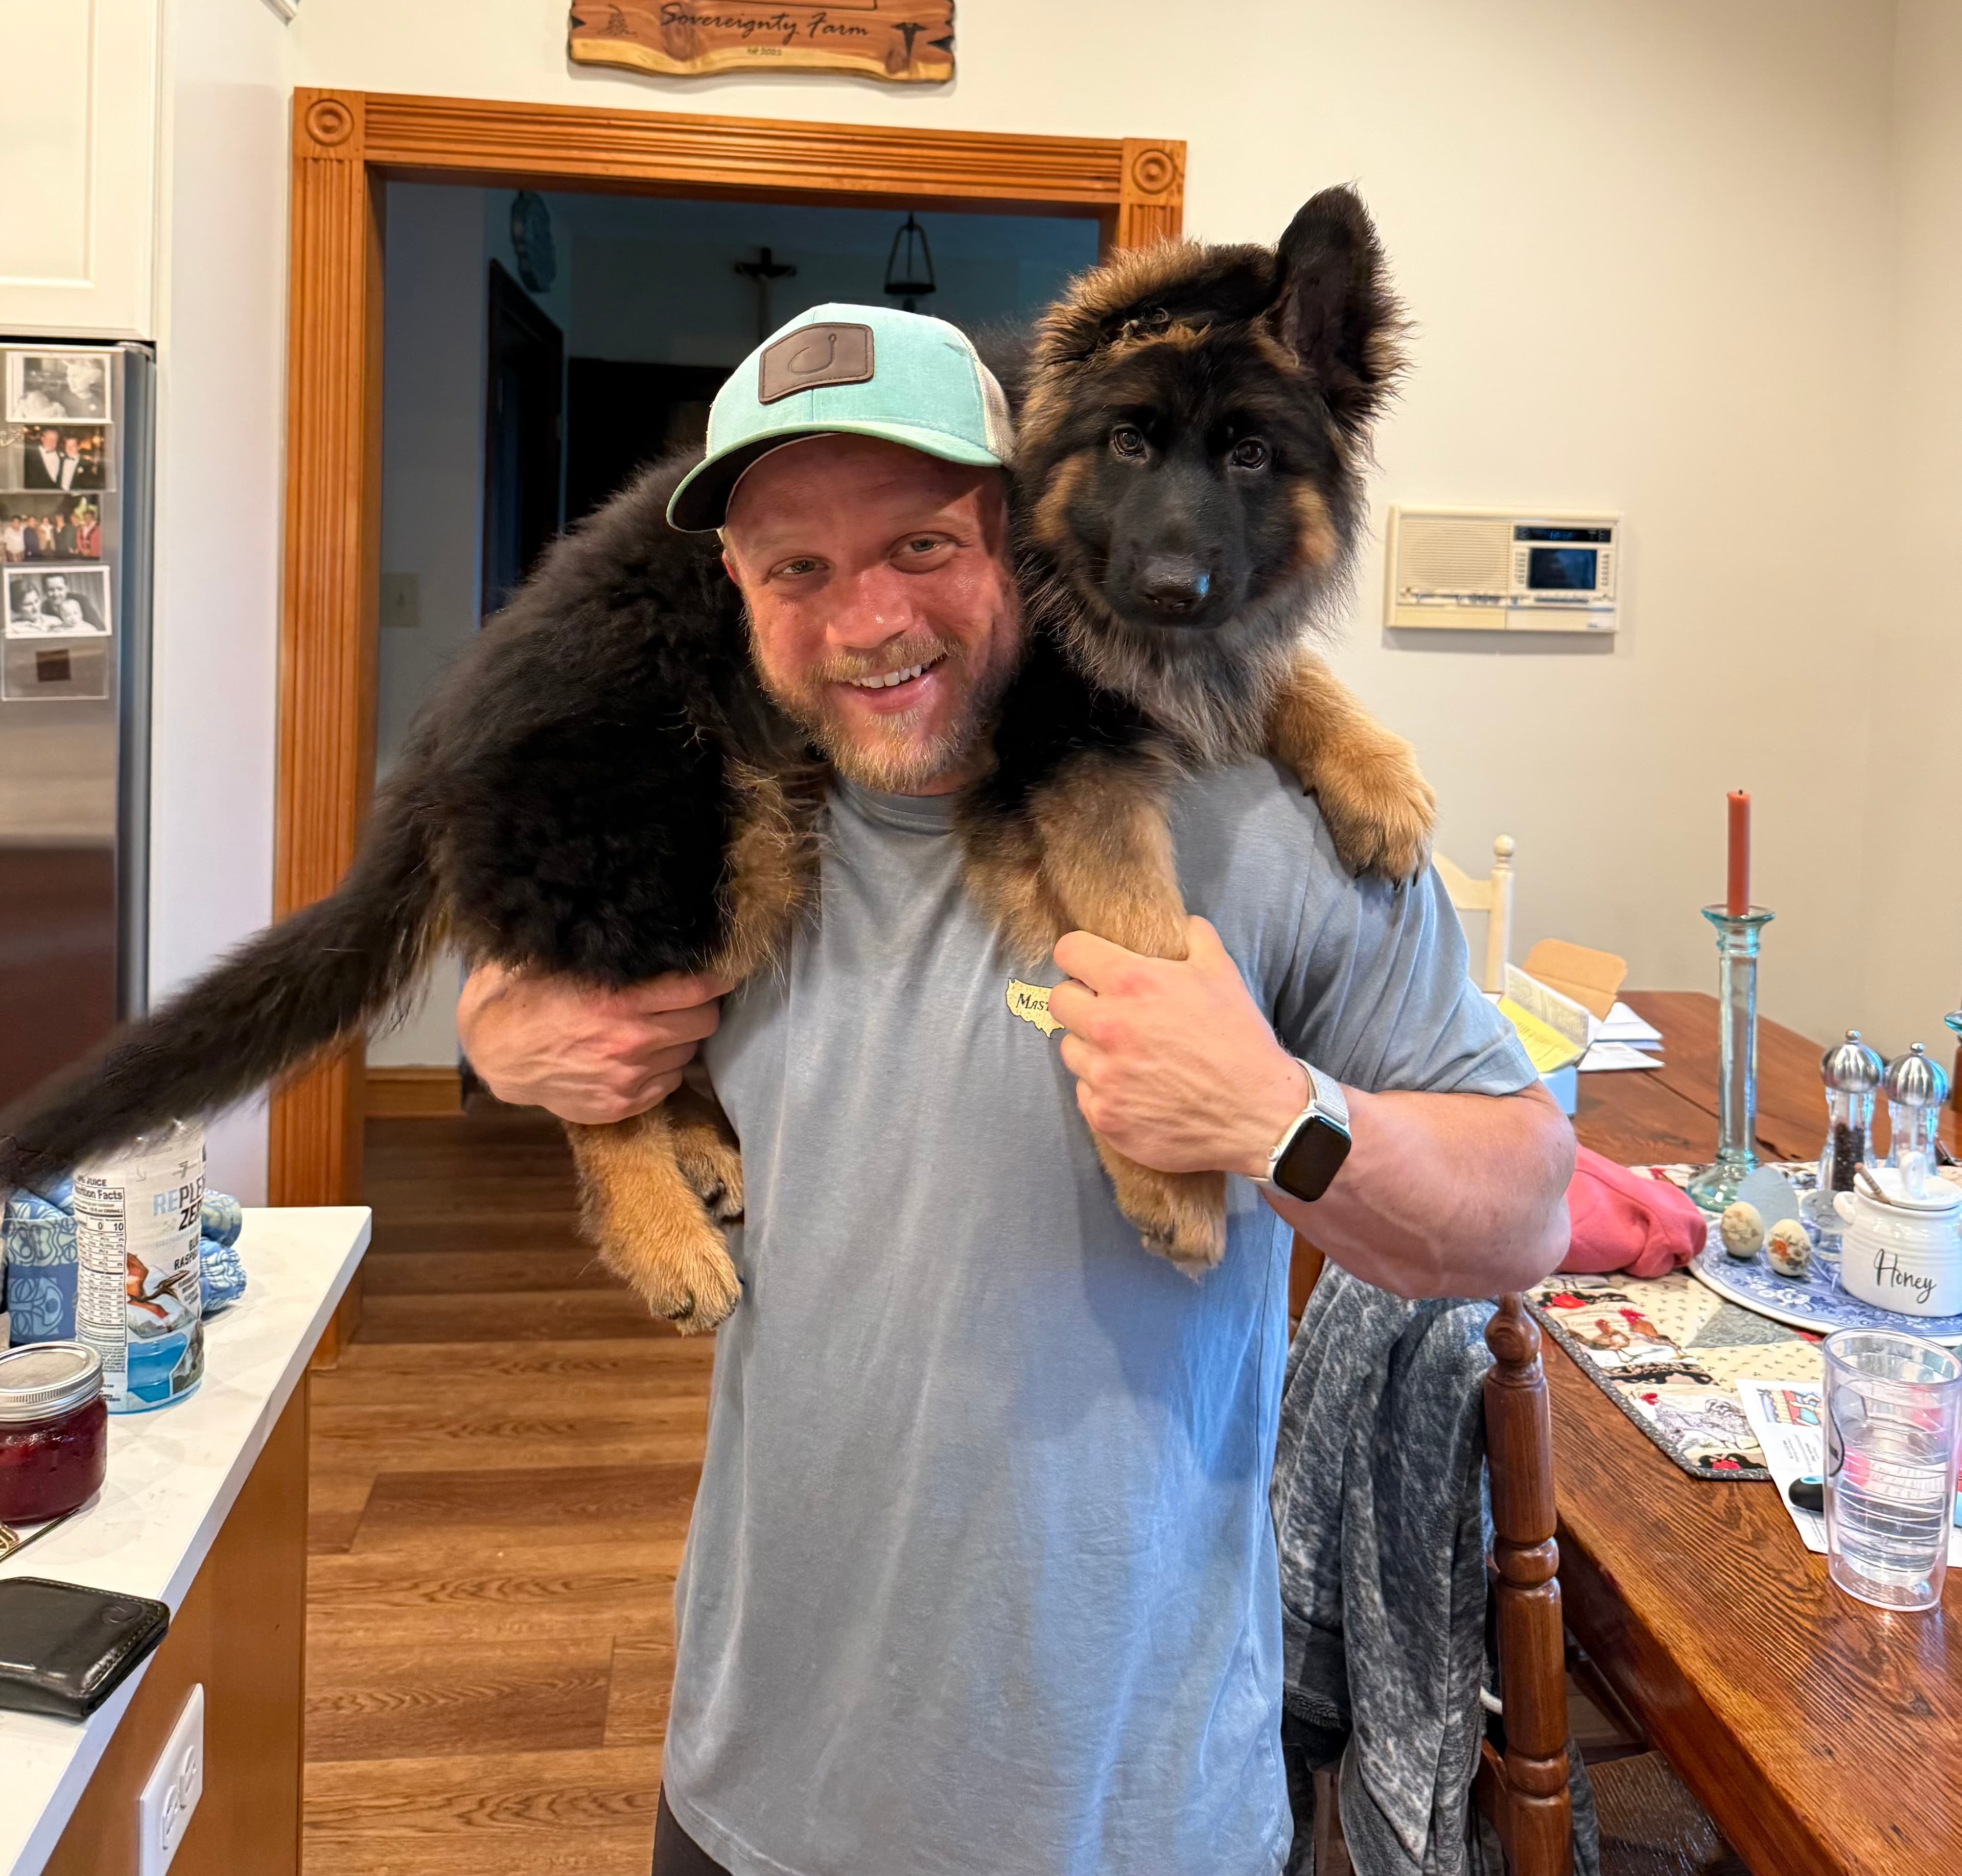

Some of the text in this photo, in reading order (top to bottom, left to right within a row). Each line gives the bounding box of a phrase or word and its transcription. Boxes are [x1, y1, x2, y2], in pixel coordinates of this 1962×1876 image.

[661, 3, 869, 46] Sovereignty Farm
[87, 1178, 107, 1187] JUICE
[97, 1189, 123, 1200] Facts
[113, 1223, 124, 1231] 10
[1873, 1248, 1937, 1304] Honey
